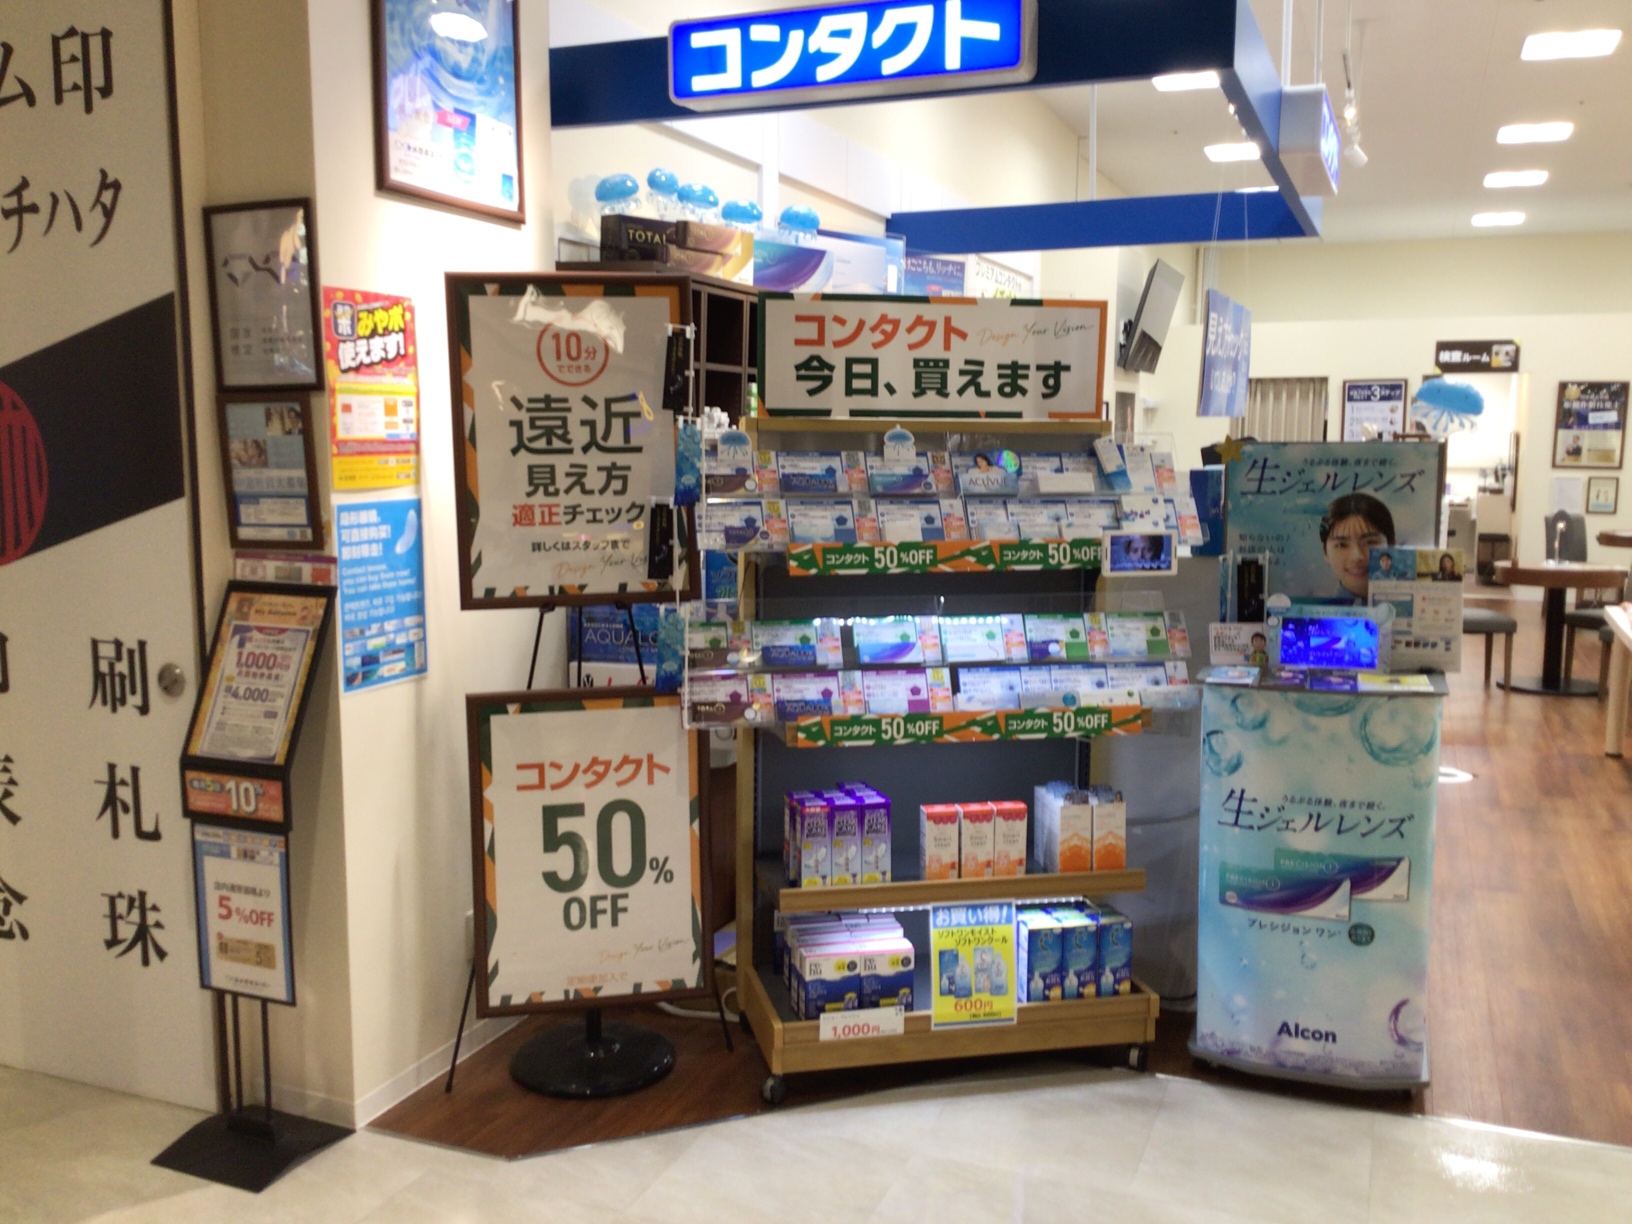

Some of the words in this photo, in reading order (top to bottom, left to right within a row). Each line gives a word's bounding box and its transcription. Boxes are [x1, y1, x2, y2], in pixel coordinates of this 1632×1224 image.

[691, 0, 1001, 91] コンタクト
[1, 168, 122, 254] チハタ
[551, 331, 597, 363] 10分
[794, 313, 969, 353] コンタクト
[793, 355, 1072, 399] 今日、買えます
[509, 393, 644, 457] 遠近
[525, 462, 632, 498] 見え方
[1240, 456, 1425, 496] 生ジェルレンズ
[512, 502, 645, 527] 適正チェック
[531, 540, 630, 553] 詳しくはスタッフまで
[826, 553, 869, 565] コンタクト
[874, 546, 934, 569] 50%OFF
[1003, 549, 1044, 561] コンタクト
[584, 628, 658, 645] AQUALO
[833, 725, 876, 736] コンタクト
[881, 717, 940, 740] 50%OFF
[1008, 718, 1048, 731] コンタクト
[1052, 711, 1109, 734] 50%OFF
[516, 753, 671, 792] コンタクト
[1218, 787, 1415, 840] 生ジェルレンズ
[541, 798, 675, 893] 50%
[217, 895, 275, 928] 5%OFF
[563, 893, 629, 932] OFF
[936, 905, 1008, 927] お買い得!
[101, 890, 168, 967] 珠
[954, 997, 994, 1013] 600円
[831, 1022, 881, 1040] 1,000円
[1277, 1020, 1338, 1044] Alcon
